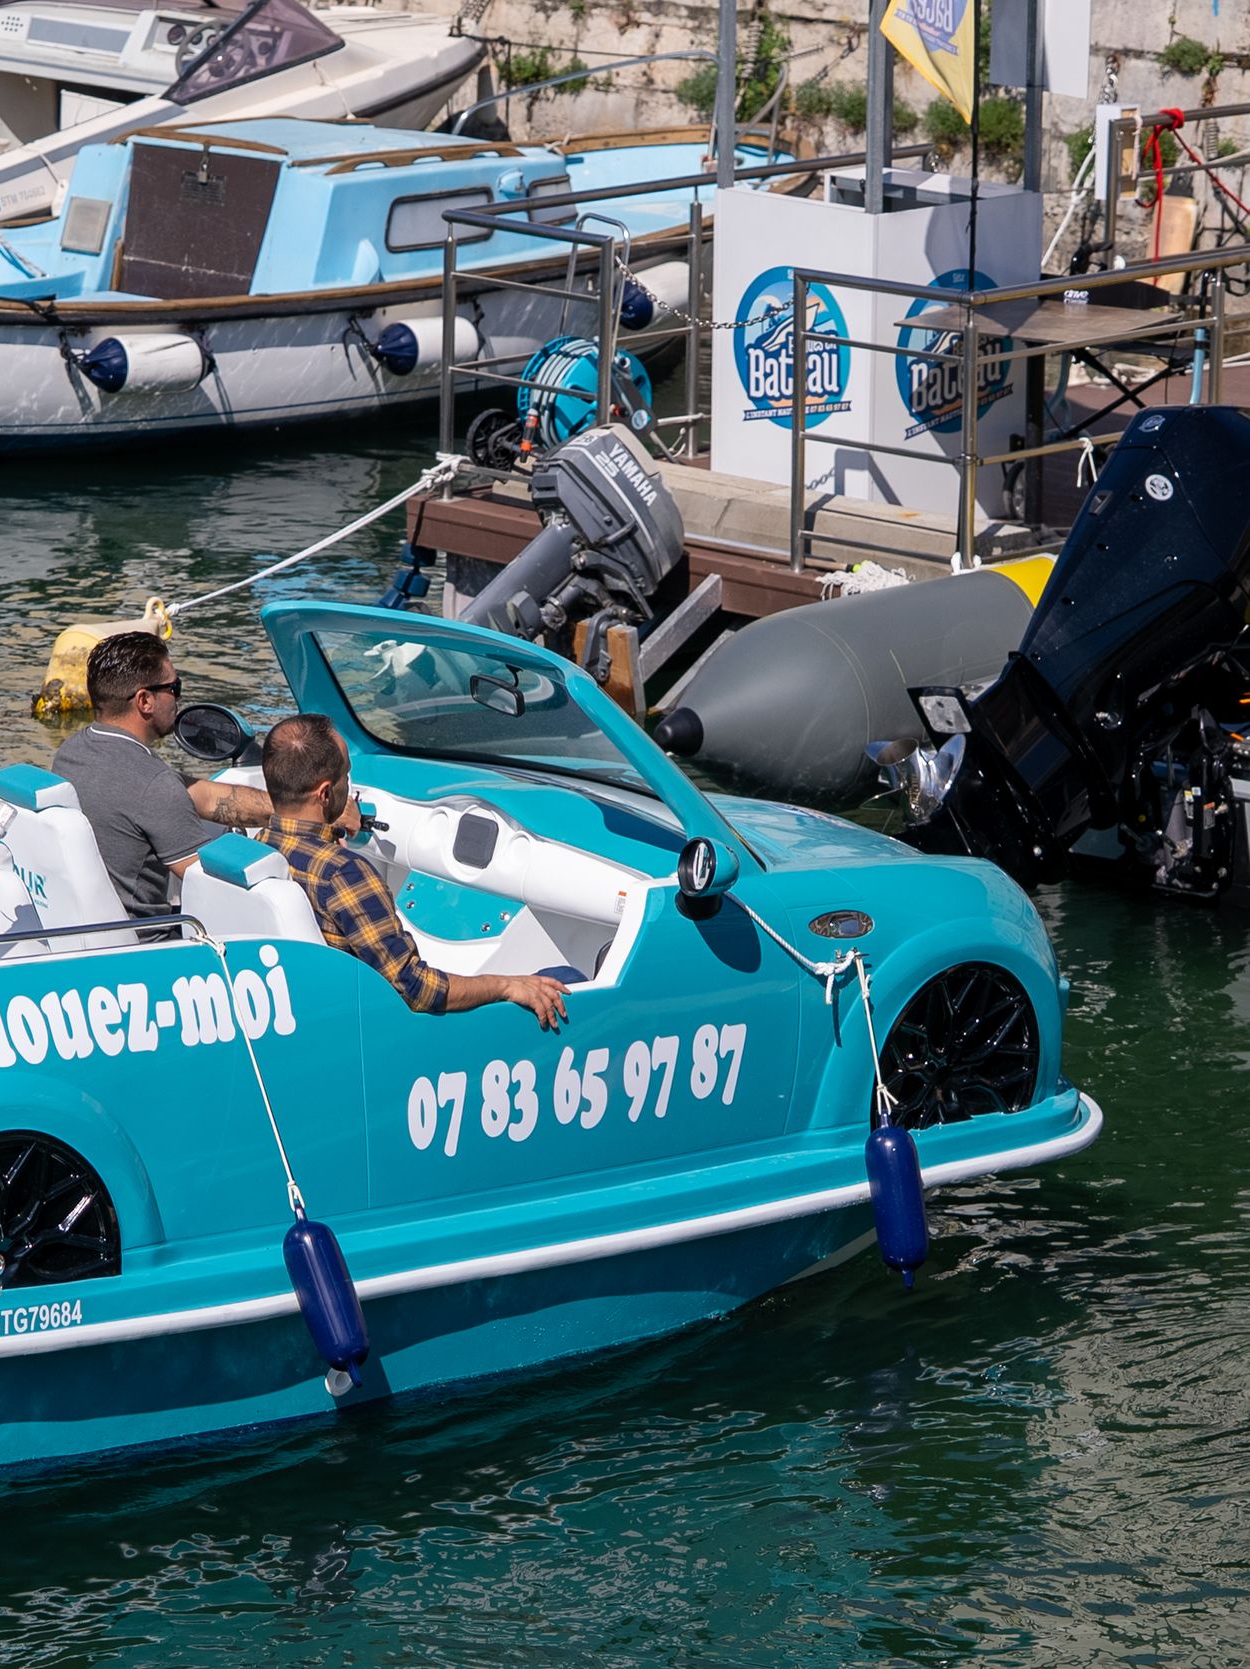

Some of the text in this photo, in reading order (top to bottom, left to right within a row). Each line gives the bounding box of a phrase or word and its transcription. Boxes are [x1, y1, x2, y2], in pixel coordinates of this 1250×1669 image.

[748, 348, 841, 399] Batau
[595, 450, 620, 479] 25
[607, 443, 658, 507] YAMAHA
[407, 1023, 747, 1157] 07 83 65 97 87
